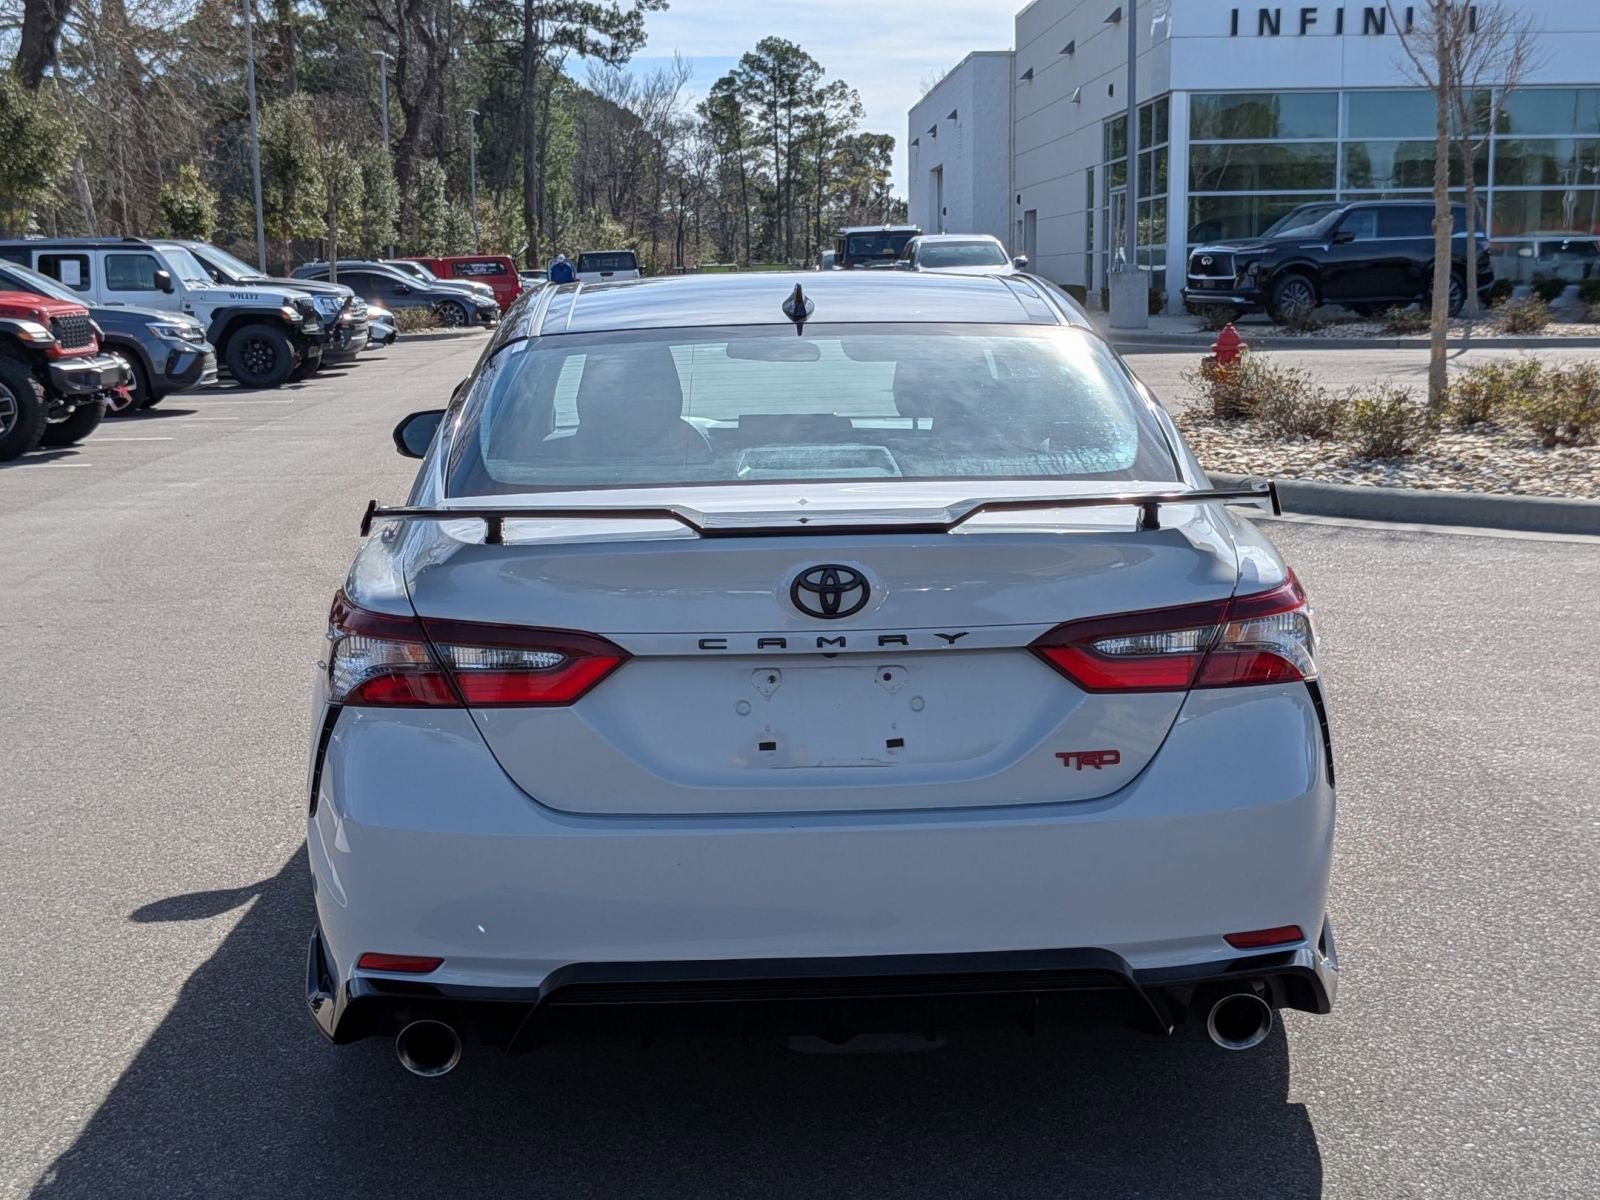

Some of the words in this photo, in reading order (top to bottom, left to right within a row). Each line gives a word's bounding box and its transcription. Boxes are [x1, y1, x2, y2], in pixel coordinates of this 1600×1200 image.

[1231, 7, 1477, 36] INFINII
[699, 632, 970, 650] CAMRY
[1055, 749, 1121, 771] TRD
